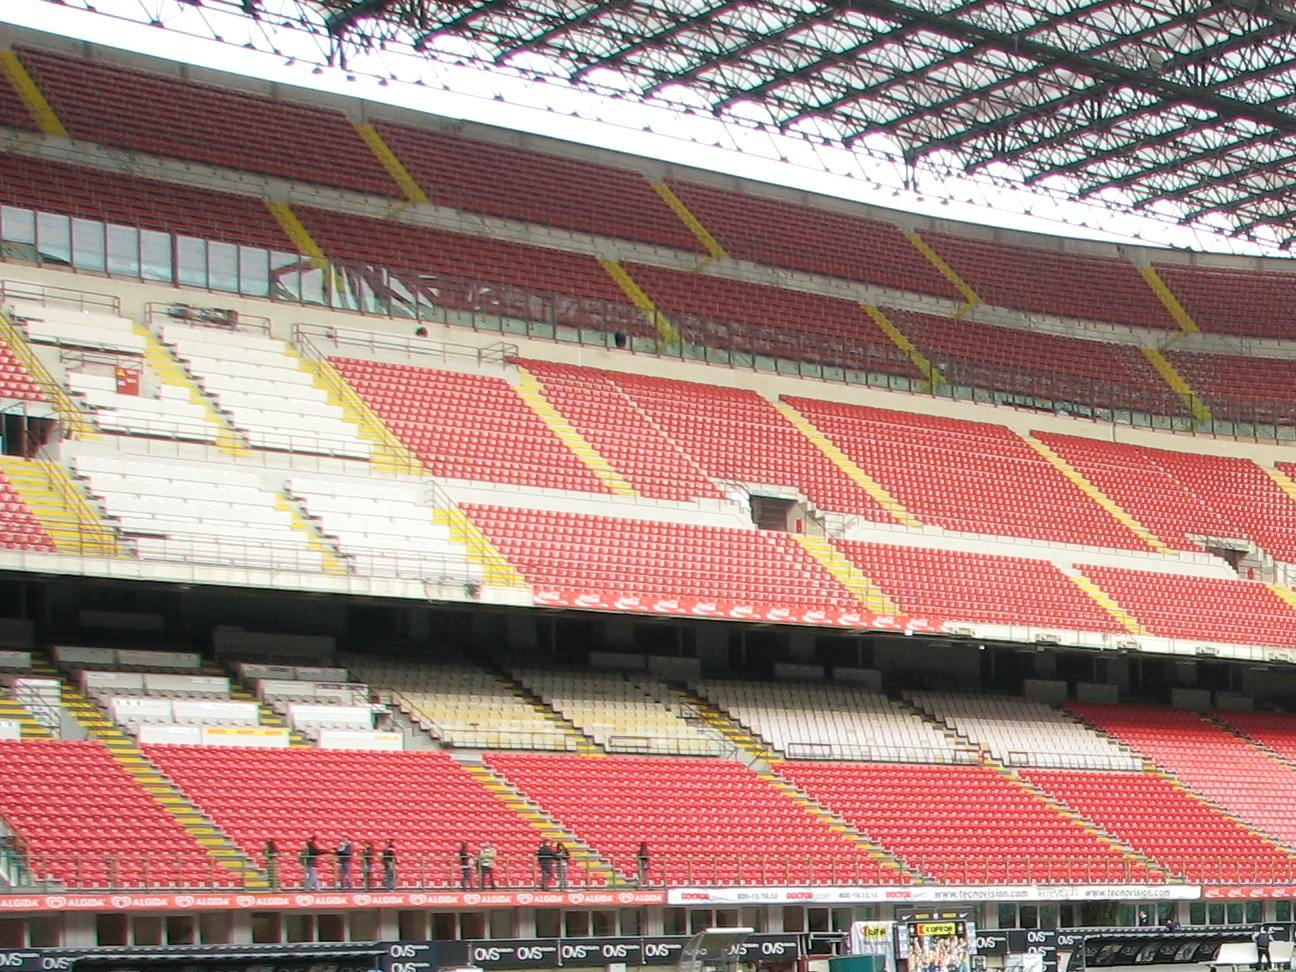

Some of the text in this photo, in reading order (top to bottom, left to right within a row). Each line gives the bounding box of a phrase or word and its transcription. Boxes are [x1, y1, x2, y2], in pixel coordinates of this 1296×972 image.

[67, 898, 105, 907] ALGIDA
[131, 897, 169, 906] ALGIDA
[195, 897, 231, 906] ALGIDA
[255, 896, 290, 905] ALGIDA
[314, 896, 348, 905] ALGIDA
[372, 895, 404, 904] ALGIDA
[427, 895, 459, 903] ALGIDA
[481, 895, 512, 903] ALGIDA
[534, 895, 564, 903] ALGIDA
[584, 894, 614, 902] ALGIDA
[634, 894, 663, 902] ALGIDA
[934, 889, 1028, 899] www.tecnovision.com
[1027, 931, 1046, 943] OVS
[391, 945, 416, 958] OVS
[475, 948, 501, 961] OVS
[518, 946, 543, 960] OVS
[562, 945, 587, 959] OVS
[603, 944, 627, 958] OVS
[645, 944, 670, 957] OVS
[762, 942, 785, 955] OVS
[976, 937, 996, 949] OVS
